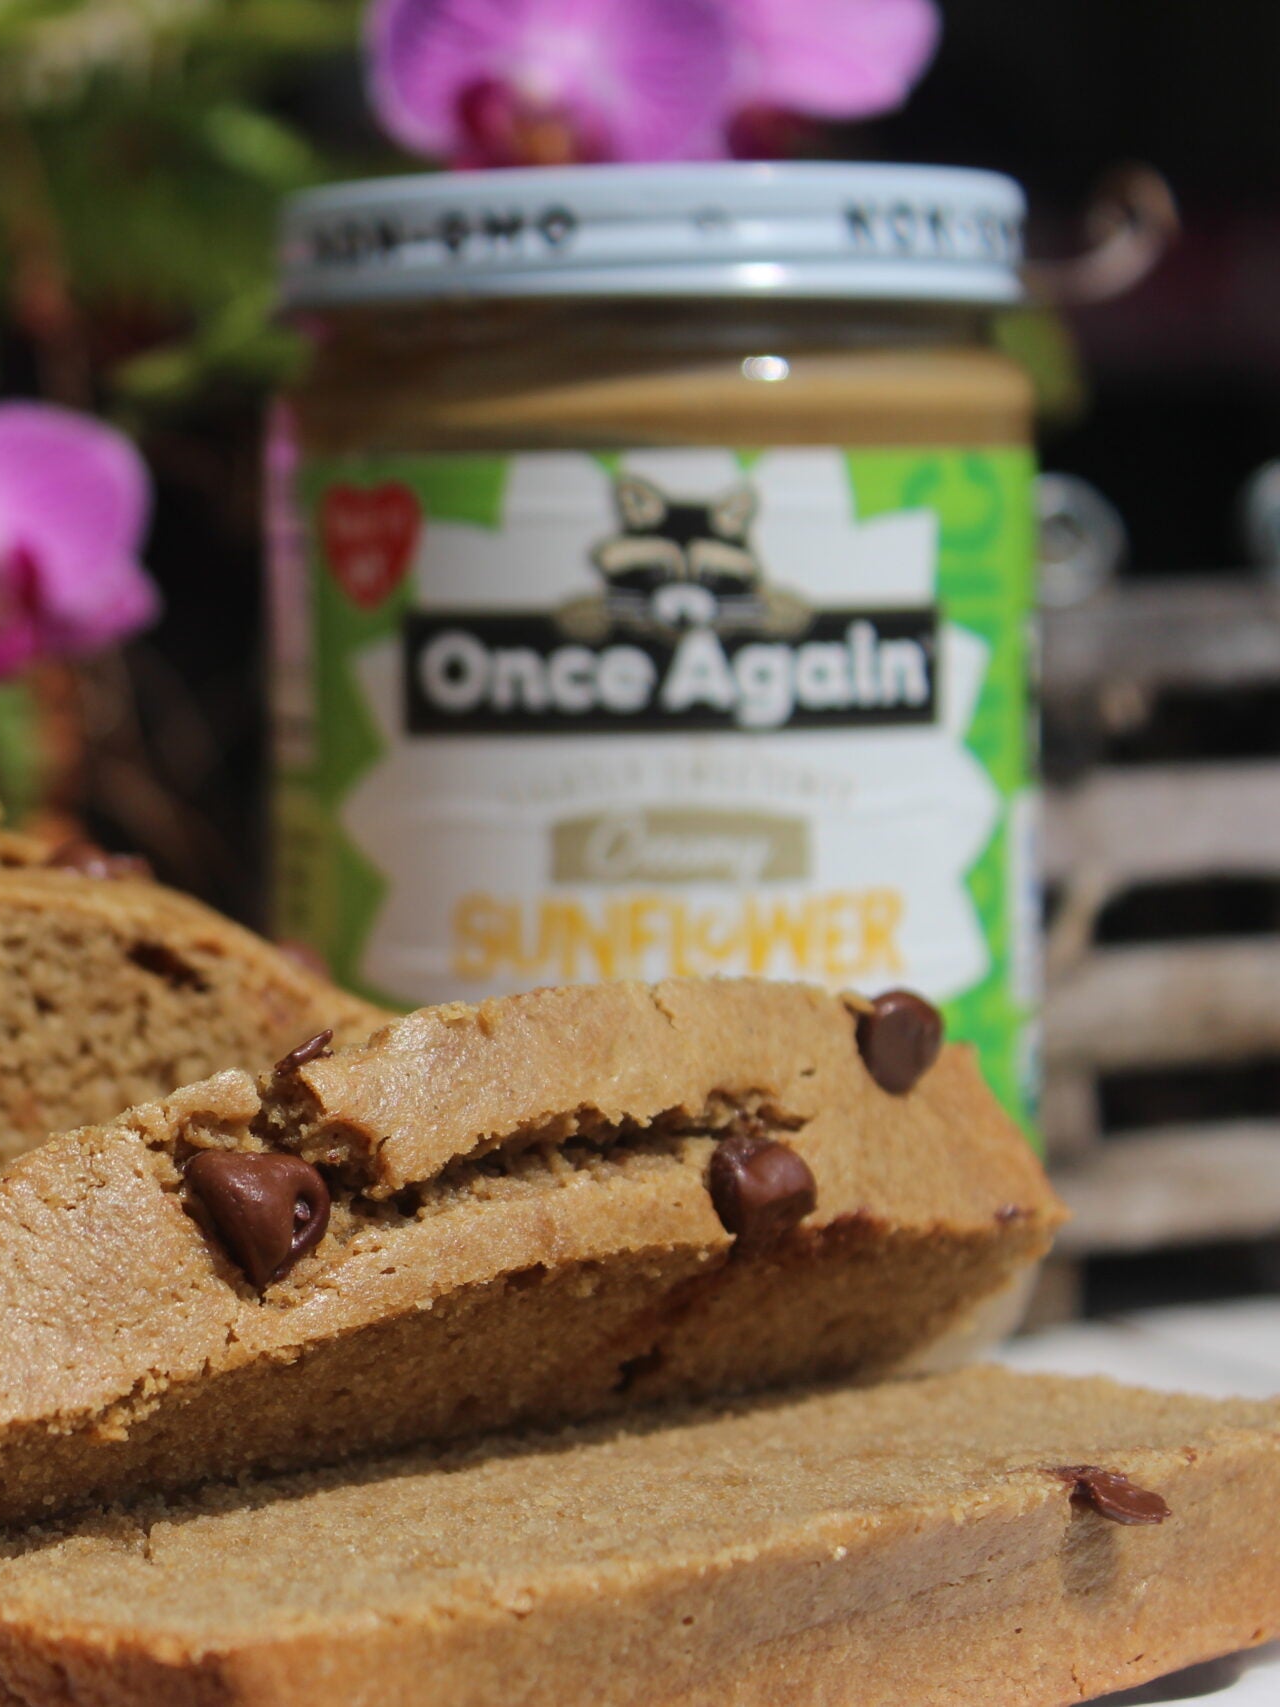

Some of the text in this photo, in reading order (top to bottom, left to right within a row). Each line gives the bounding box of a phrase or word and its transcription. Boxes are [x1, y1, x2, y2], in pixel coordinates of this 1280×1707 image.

[421, 623, 929, 729] Once Again
[452, 888, 903, 978] SUNFLOWER
